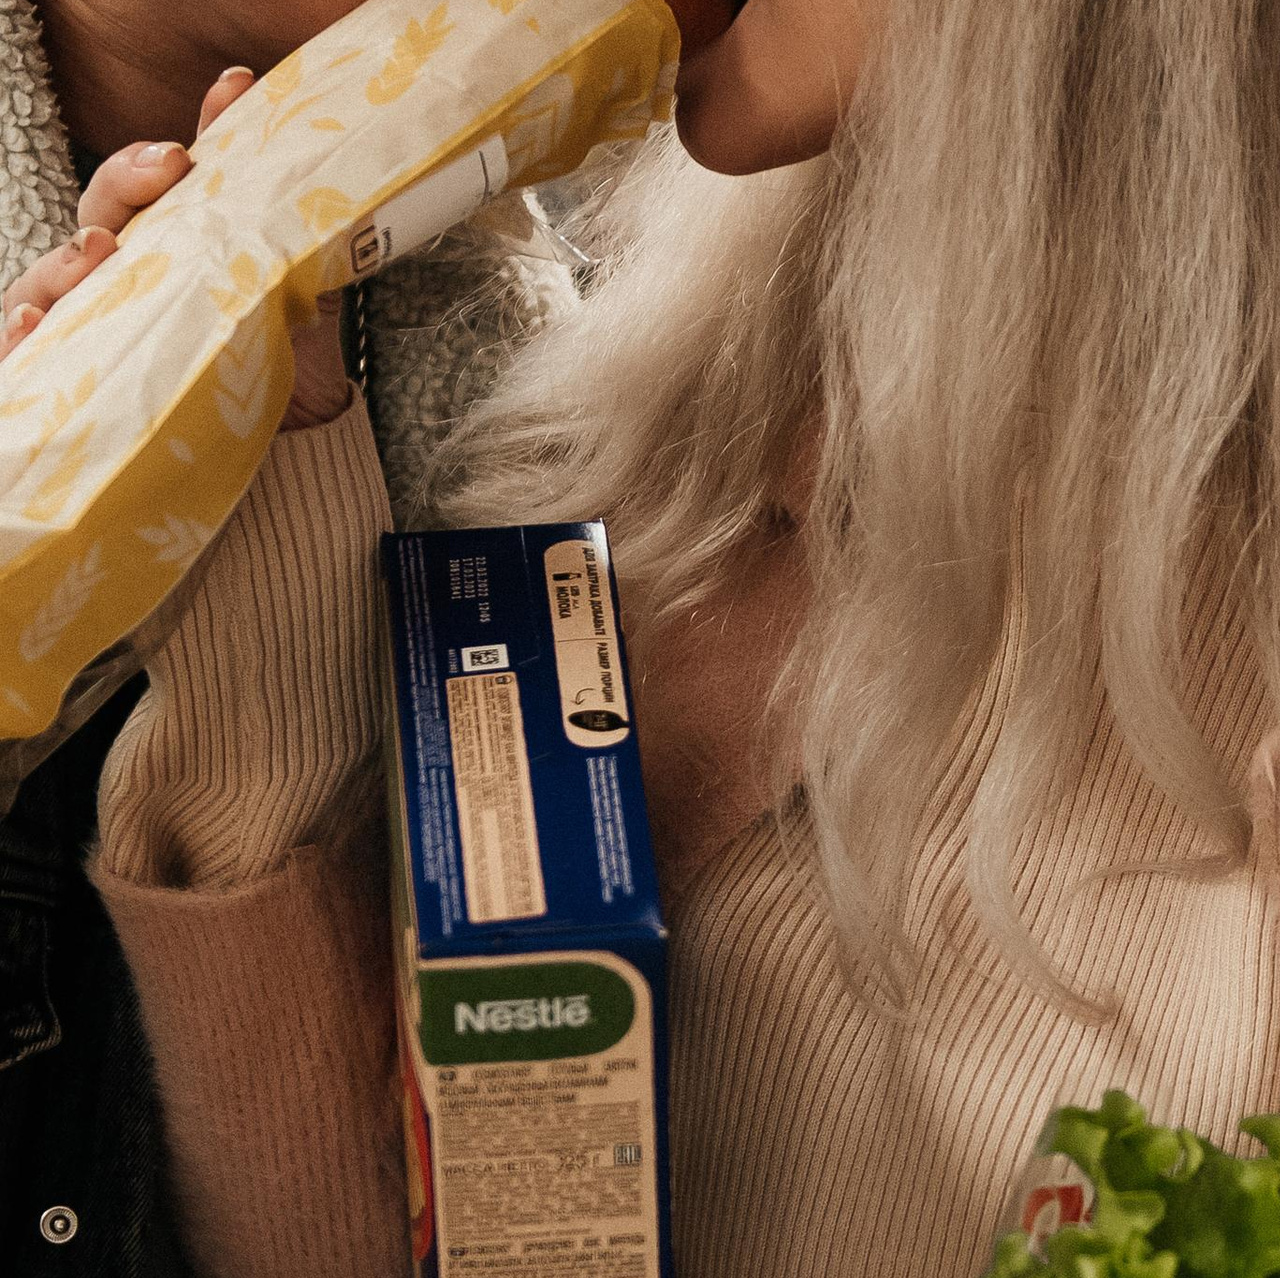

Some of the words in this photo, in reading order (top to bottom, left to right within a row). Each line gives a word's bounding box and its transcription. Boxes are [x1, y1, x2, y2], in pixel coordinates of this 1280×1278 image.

[587, 562, 603, 602] ЗАВТРАКА
[556, 586, 571, 620] МОЛОКА
[590, 599, 607, 636] ДОБАВЬТЕ
[597, 642, 611, 670] РАЗМЕР
[600, 671, 614, 703] ПОРЦИИ
